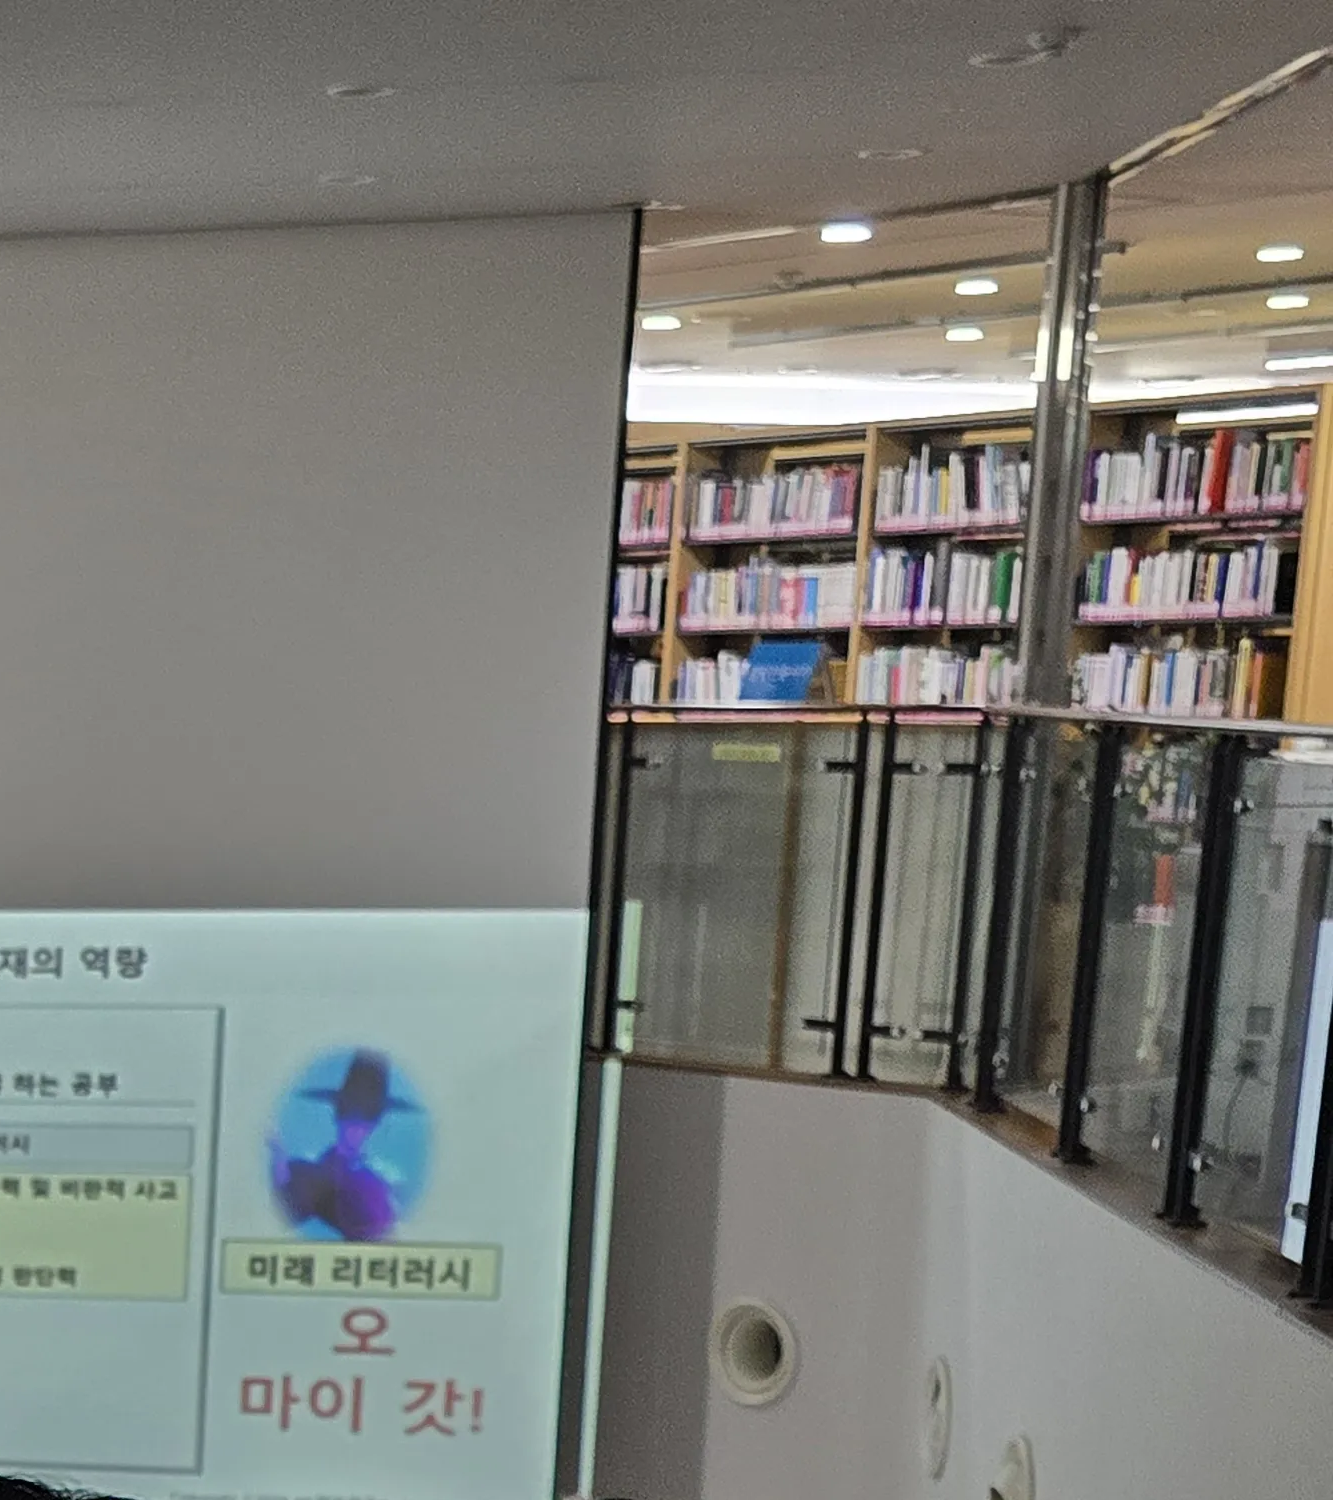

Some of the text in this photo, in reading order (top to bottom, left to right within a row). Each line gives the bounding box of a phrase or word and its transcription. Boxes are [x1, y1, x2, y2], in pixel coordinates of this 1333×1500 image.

[79, 946, 148, 979] 역량
[13, 1072, 59, 1097] 하는
[72, 1073, 119, 1099] 공부
[134, 1178, 178, 1201] 사고
[247, 1252, 473, 1292] 미래 리터러시
[331, 1306, 396, 1356] 오
[239, 1373, 485, 1438] 마이 갓!
